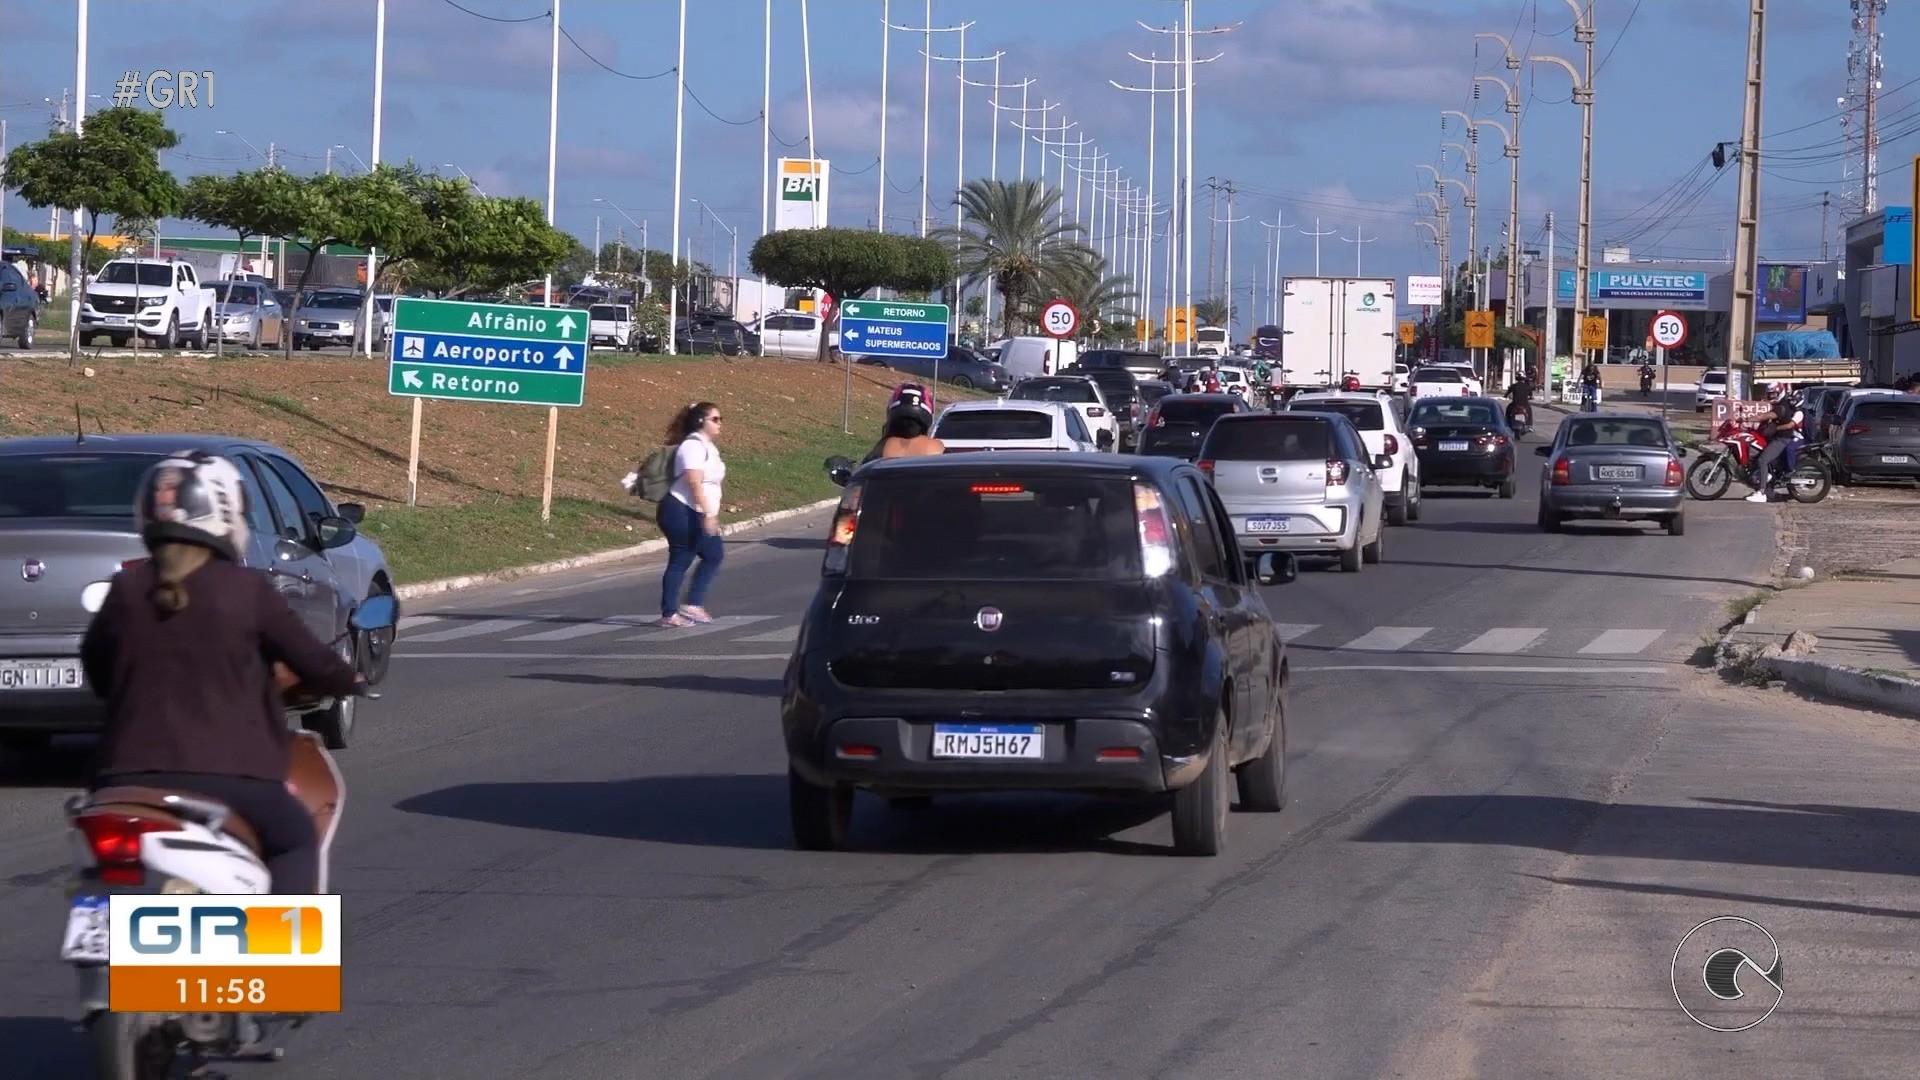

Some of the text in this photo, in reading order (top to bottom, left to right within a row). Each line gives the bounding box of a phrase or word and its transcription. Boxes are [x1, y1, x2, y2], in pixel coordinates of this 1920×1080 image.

[1610, 275, 1695, 288] PULVETEC
[883, 308, 926, 318] RETORNO
[1051, 311, 1071, 325] 50
[467, 312, 547, 333] Afrânio
[1660, 322, 1680, 335] 50
[867, 325, 902, 335] MATEUS
[865, 339, 941, 351] SUPERMERCADOS
[433, 341, 545, 364] Aeroporto
[431, 372, 520, 394] Retorno
[1732, 401, 1771, 413] Portal
[944, 734, 1031, 755] RMJ5H67
